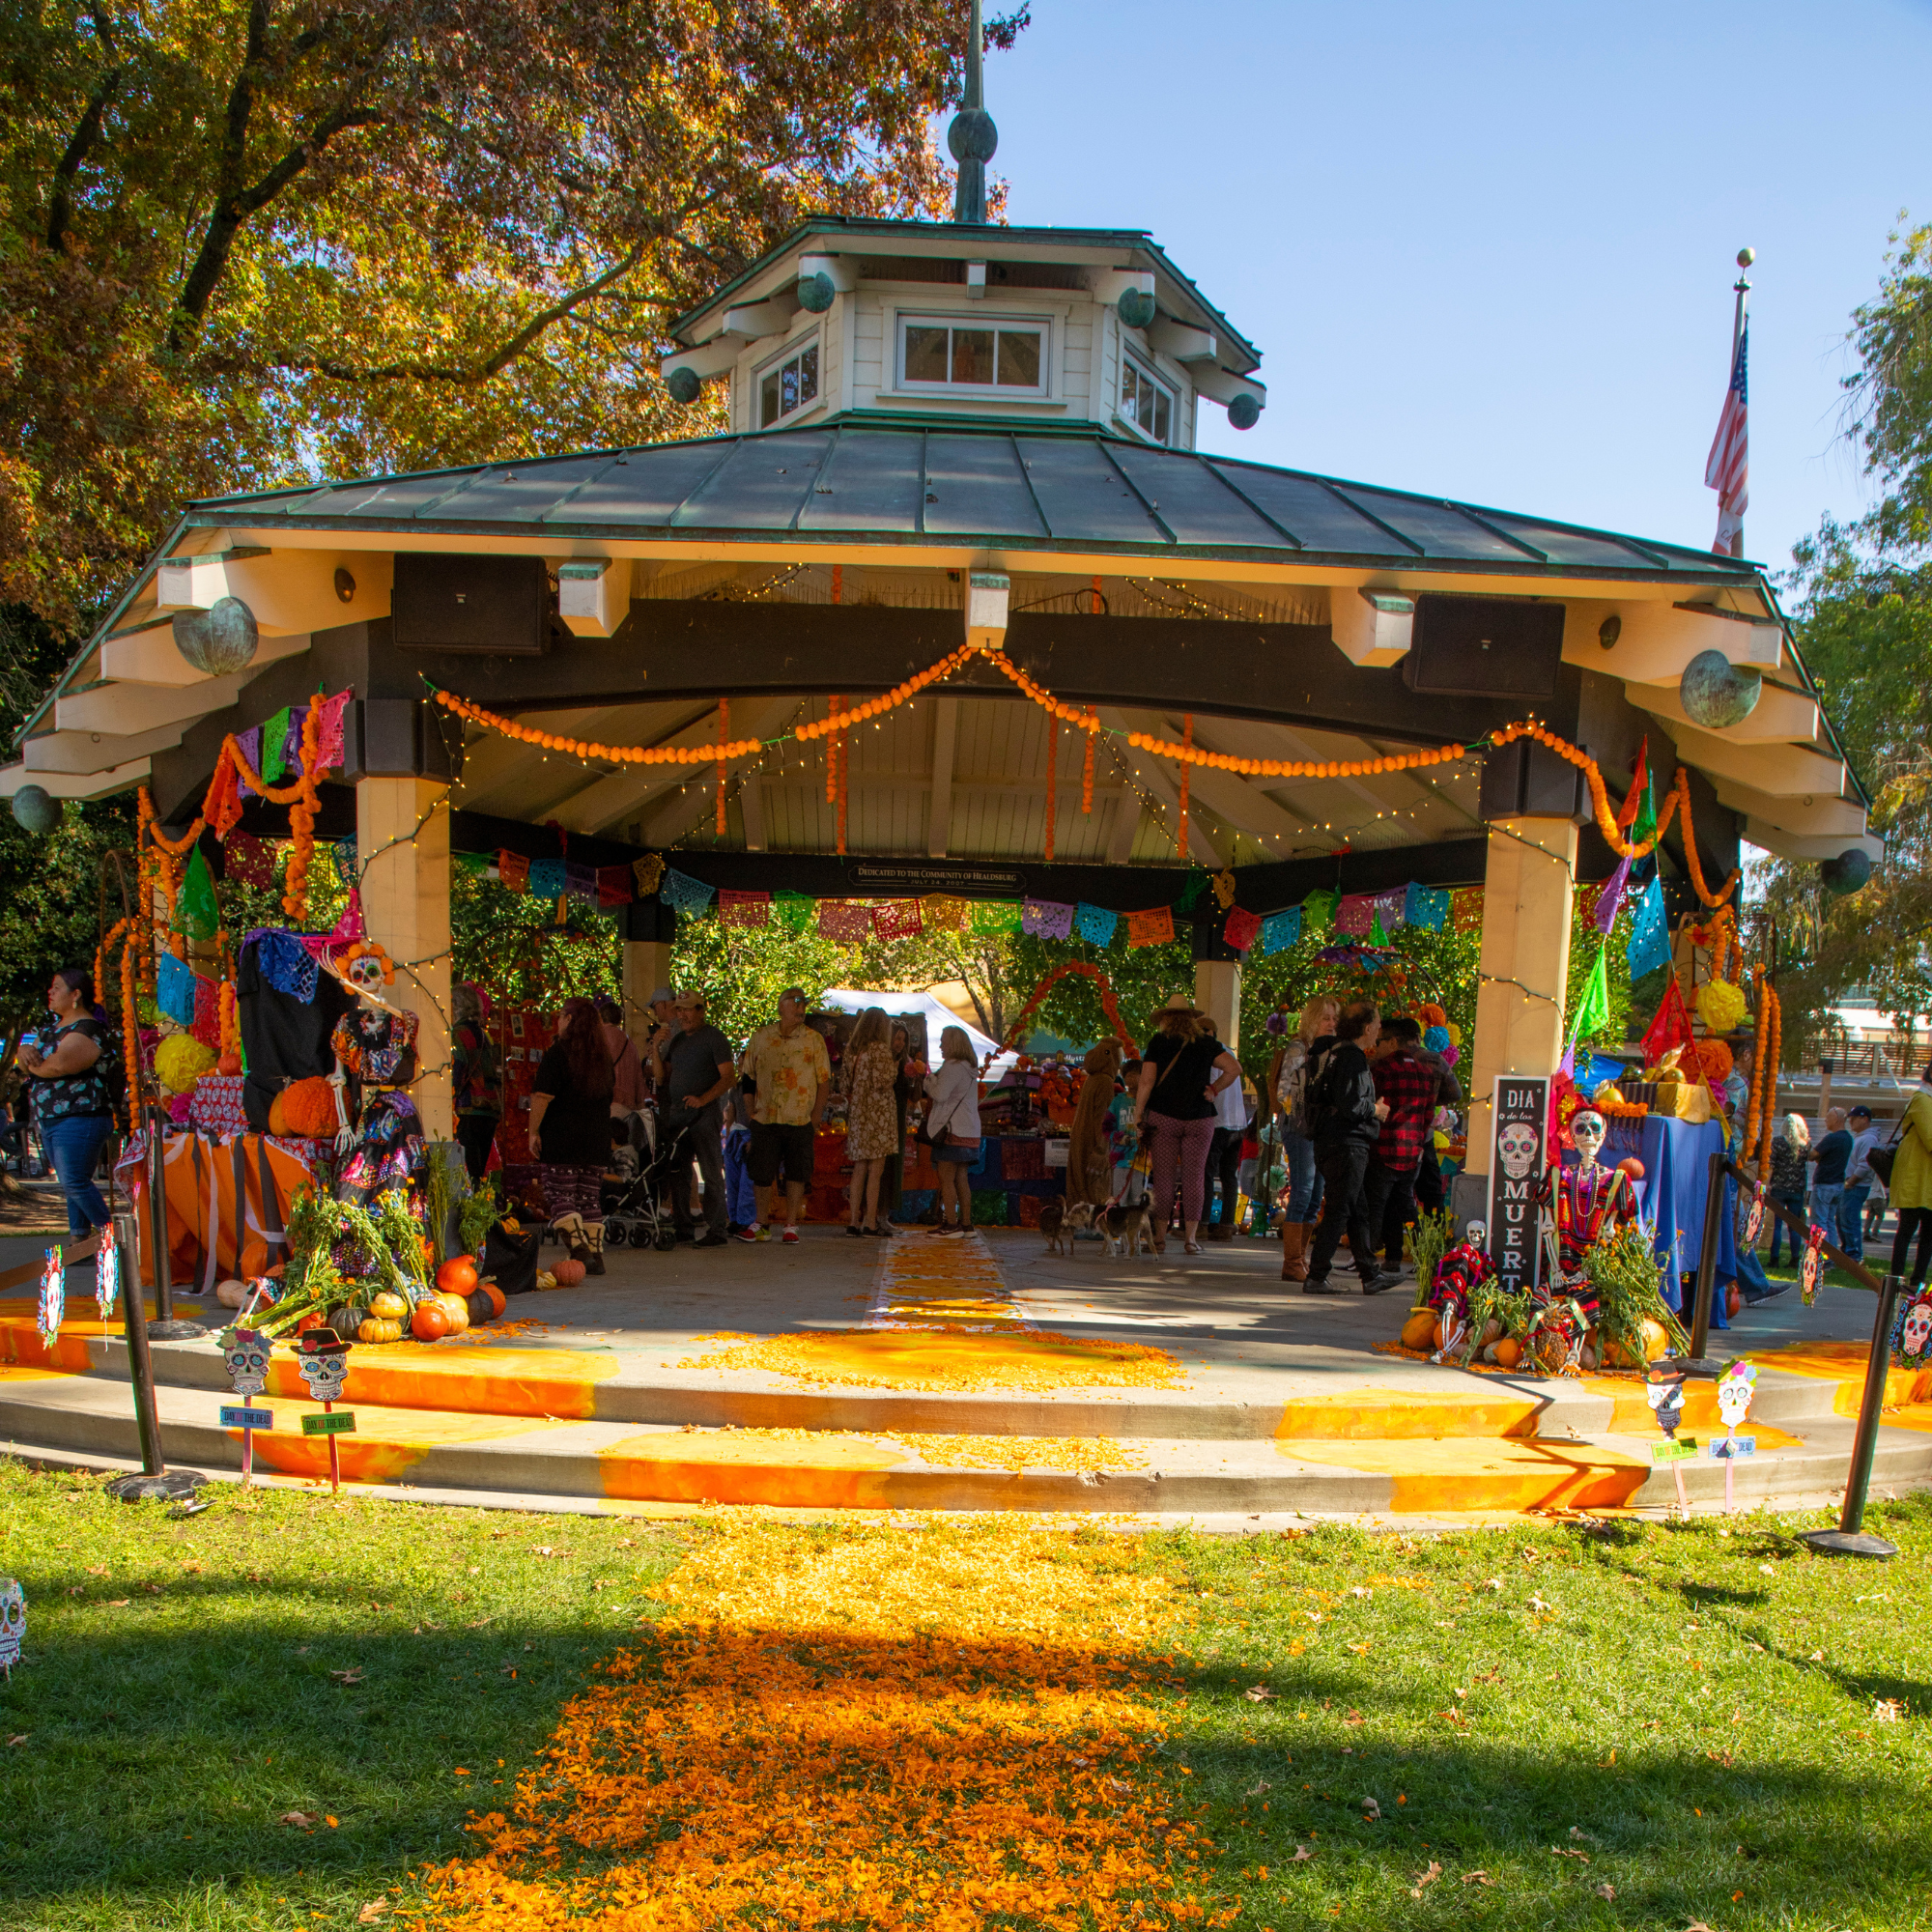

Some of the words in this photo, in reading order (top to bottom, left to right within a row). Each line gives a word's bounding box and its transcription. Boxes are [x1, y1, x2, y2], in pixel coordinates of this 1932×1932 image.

[858, 867, 895, 876] DEDICATED
[921, 869, 962, 879] COMMUNITY
[973, 871, 1016, 882] HEALDSBURG
[1507, 1090, 1534, 1108] DIA
[1520, 1111, 1534, 1120] los
[224, 1411, 235, 1421] DAY
[236, 1411, 243, 1422] OF
[244, 1412, 255, 1423] THE
[256, 1414, 270, 1425] DEAD
[305, 1419, 318, 1430] DAY
[318, 1419, 325, 1429] OF
[326, 1418, 337, 1429] THE
[338, 1417, 354, 1428] DEAD
[1671, 1444, 1681, 1455] THE
[1739, 1441, 1752, 1452] DEAD
